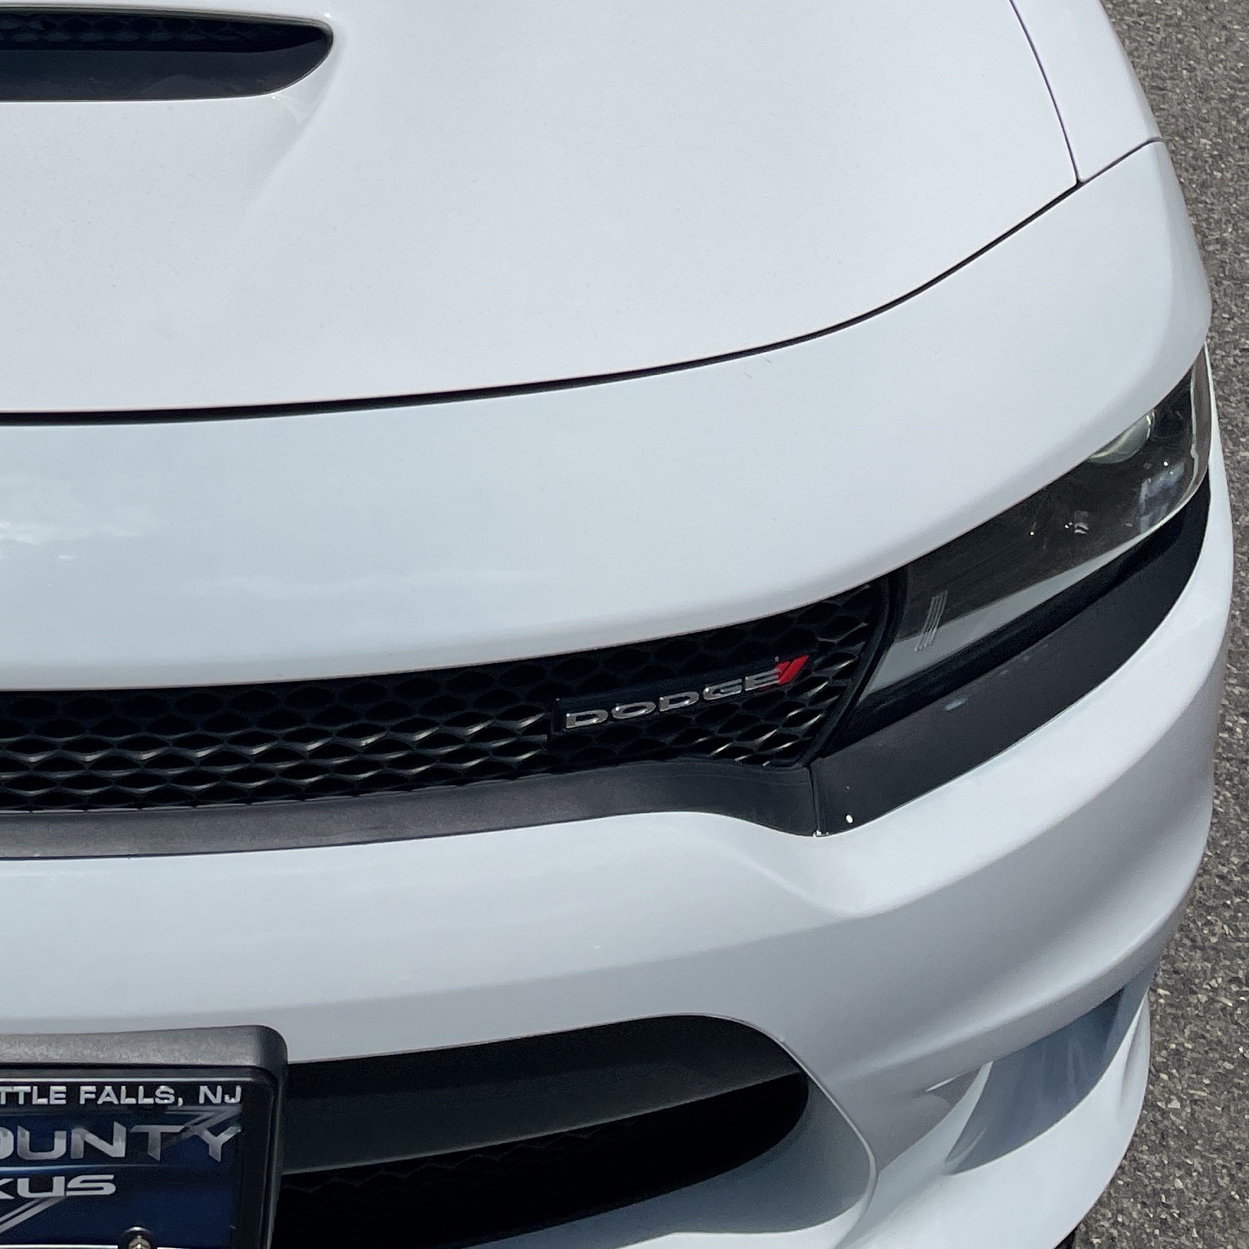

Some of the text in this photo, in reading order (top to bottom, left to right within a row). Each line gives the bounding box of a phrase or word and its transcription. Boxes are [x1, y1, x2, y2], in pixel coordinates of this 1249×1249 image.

[565, 667, 784, 729] DODGE
[78, 1085, 184, 1107] FALLS,
[198, 1085, 243, 1105] NJ
